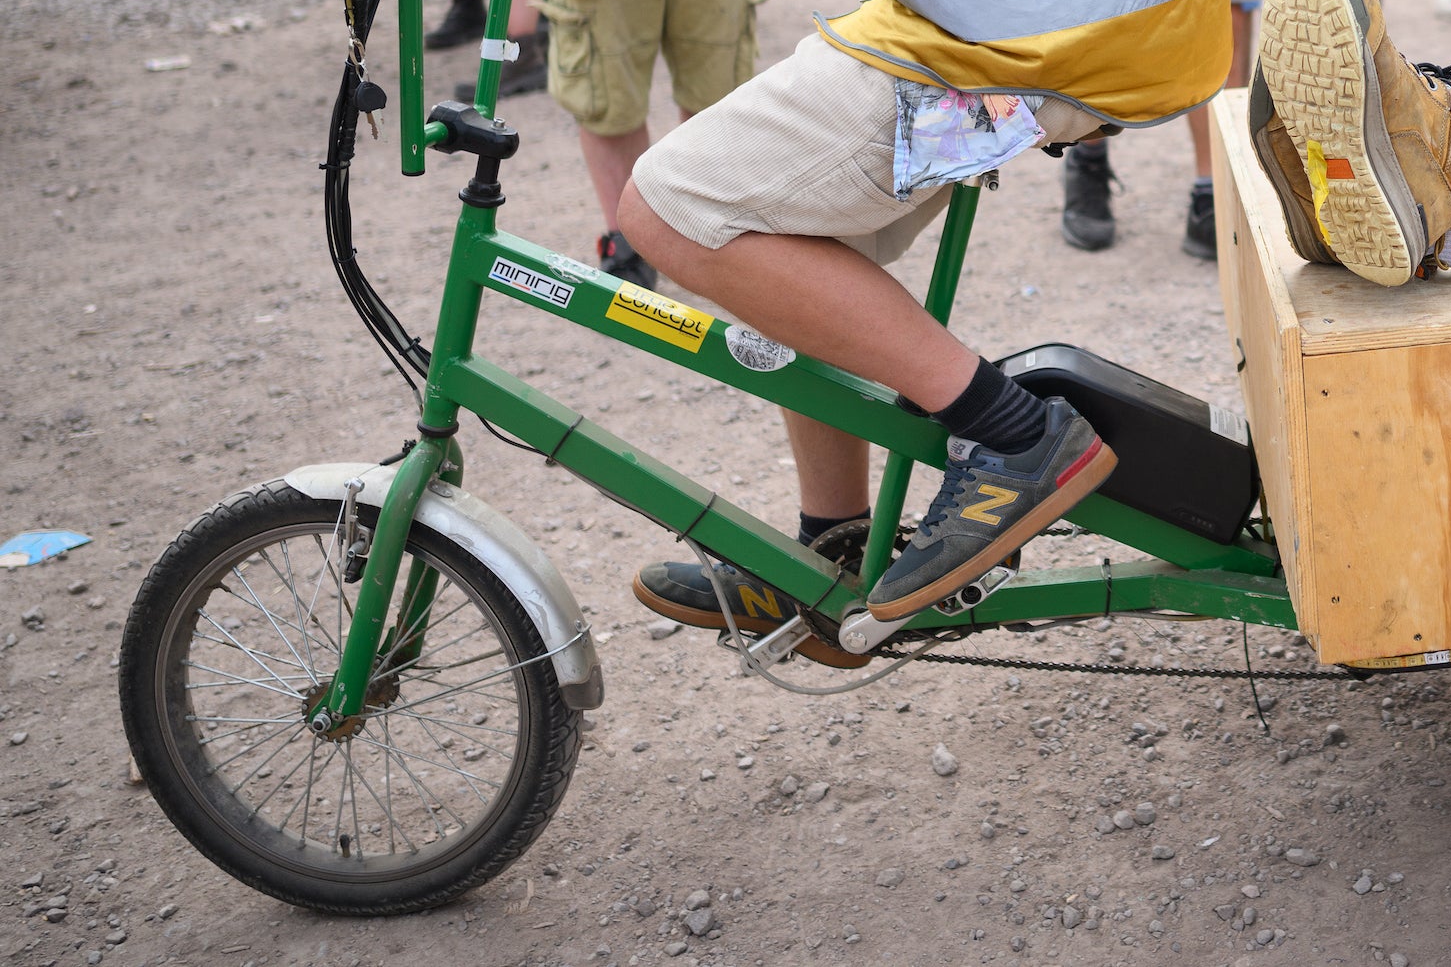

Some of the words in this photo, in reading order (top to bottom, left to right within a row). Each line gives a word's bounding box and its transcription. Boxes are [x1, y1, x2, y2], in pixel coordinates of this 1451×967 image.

[492, 261, 571, 306] minirig
[960, 484, 1020, 526] N
[738, 584, 782, 618] N
